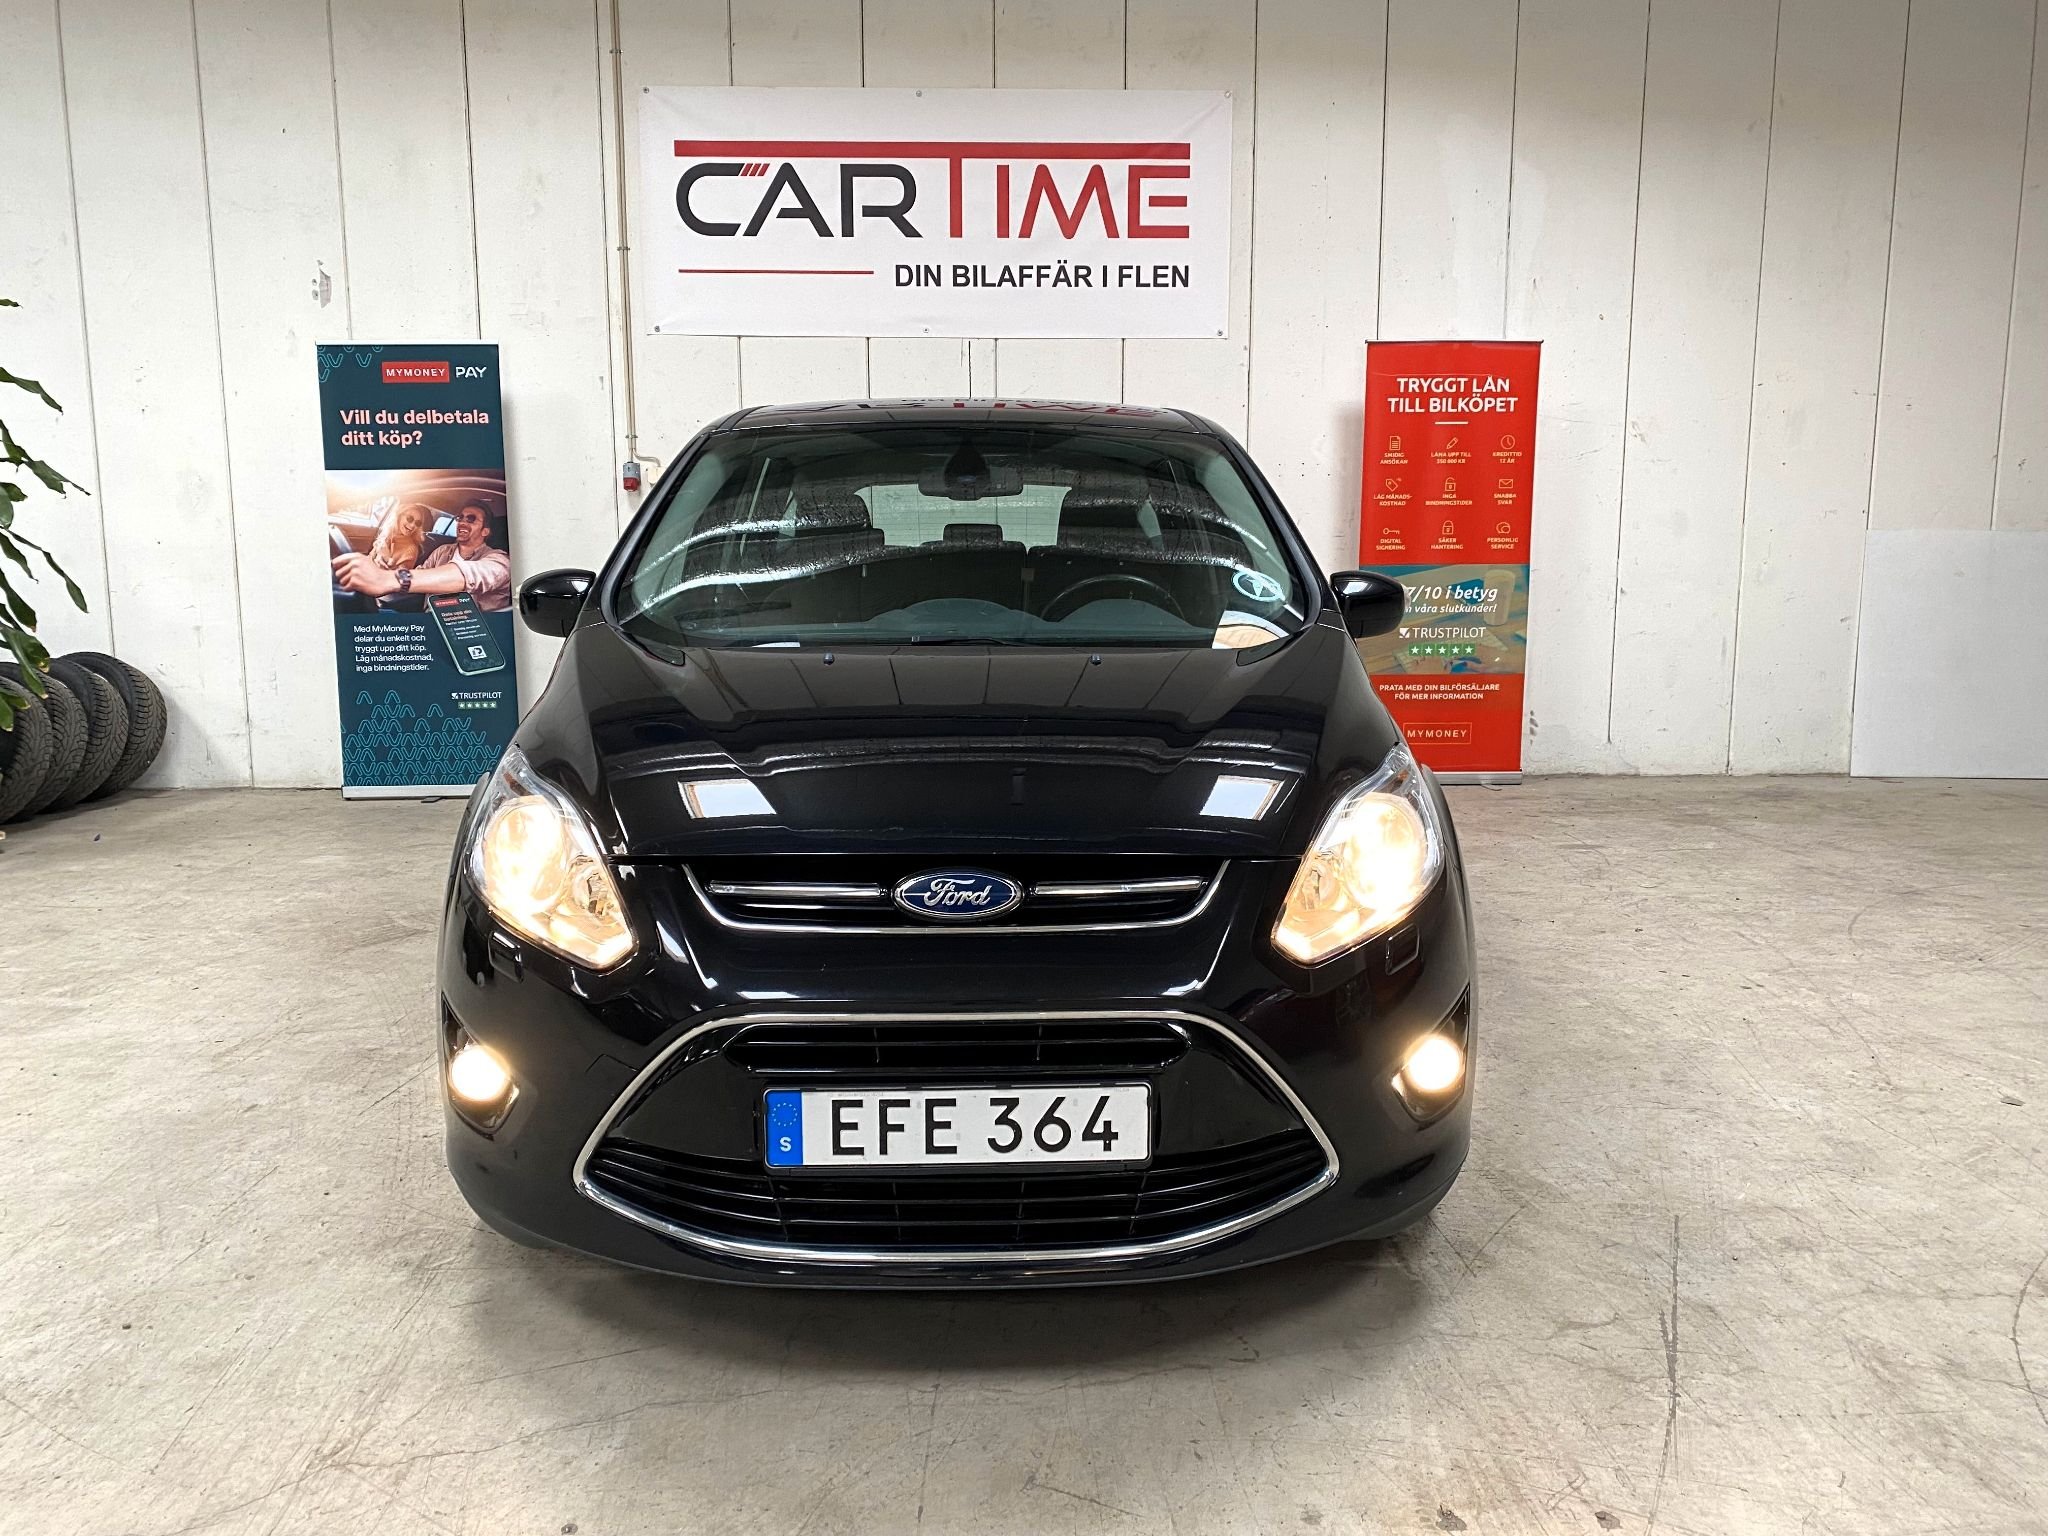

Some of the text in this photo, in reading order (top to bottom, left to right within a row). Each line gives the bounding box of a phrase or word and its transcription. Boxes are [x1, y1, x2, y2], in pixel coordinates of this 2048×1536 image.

[675, 140, 1191, 239] CARTIME
[895, 260, 1189, 288] DIN BILAFFÄR I FLEN
[386, 367, 487, 378] MYMONEY PAY
[1397, 375, 1510, 393] TRYGGT LÅN
[1387, 393, 1518, 413] TILL BILKÖPET
[340, 409, 489, 425] Vill du delbetala
[341, 430, 423, 448] ditt köp?
[1445, 586, 1452, 599] i
[1454, 585, 1498, 602] betyg
[1415, 604, 1437, 613] våra
[1440, 604, 1497, 613] slutkunder!
[372, 625, 409, 633] MyMoney
[1412, 627, 1486, 638] TRUSTPILOT
[410, 644, 426, 652] köp.
[355, 654, 434, 663] Låg månadskostnad,
[356, 664, 430, 673] inga bindningstider.
[1440, 683, 1500, 691] BILFÖRSÄLJARE
[1395, 692, 1410, 700] FÖR
[1407, 729, 1467, 738] MYMONEY
[923, 878, 992, 907] Ford
[831, 1095, 1119, 1156] EFE 364
[779, 1136, 792, 1153] S
